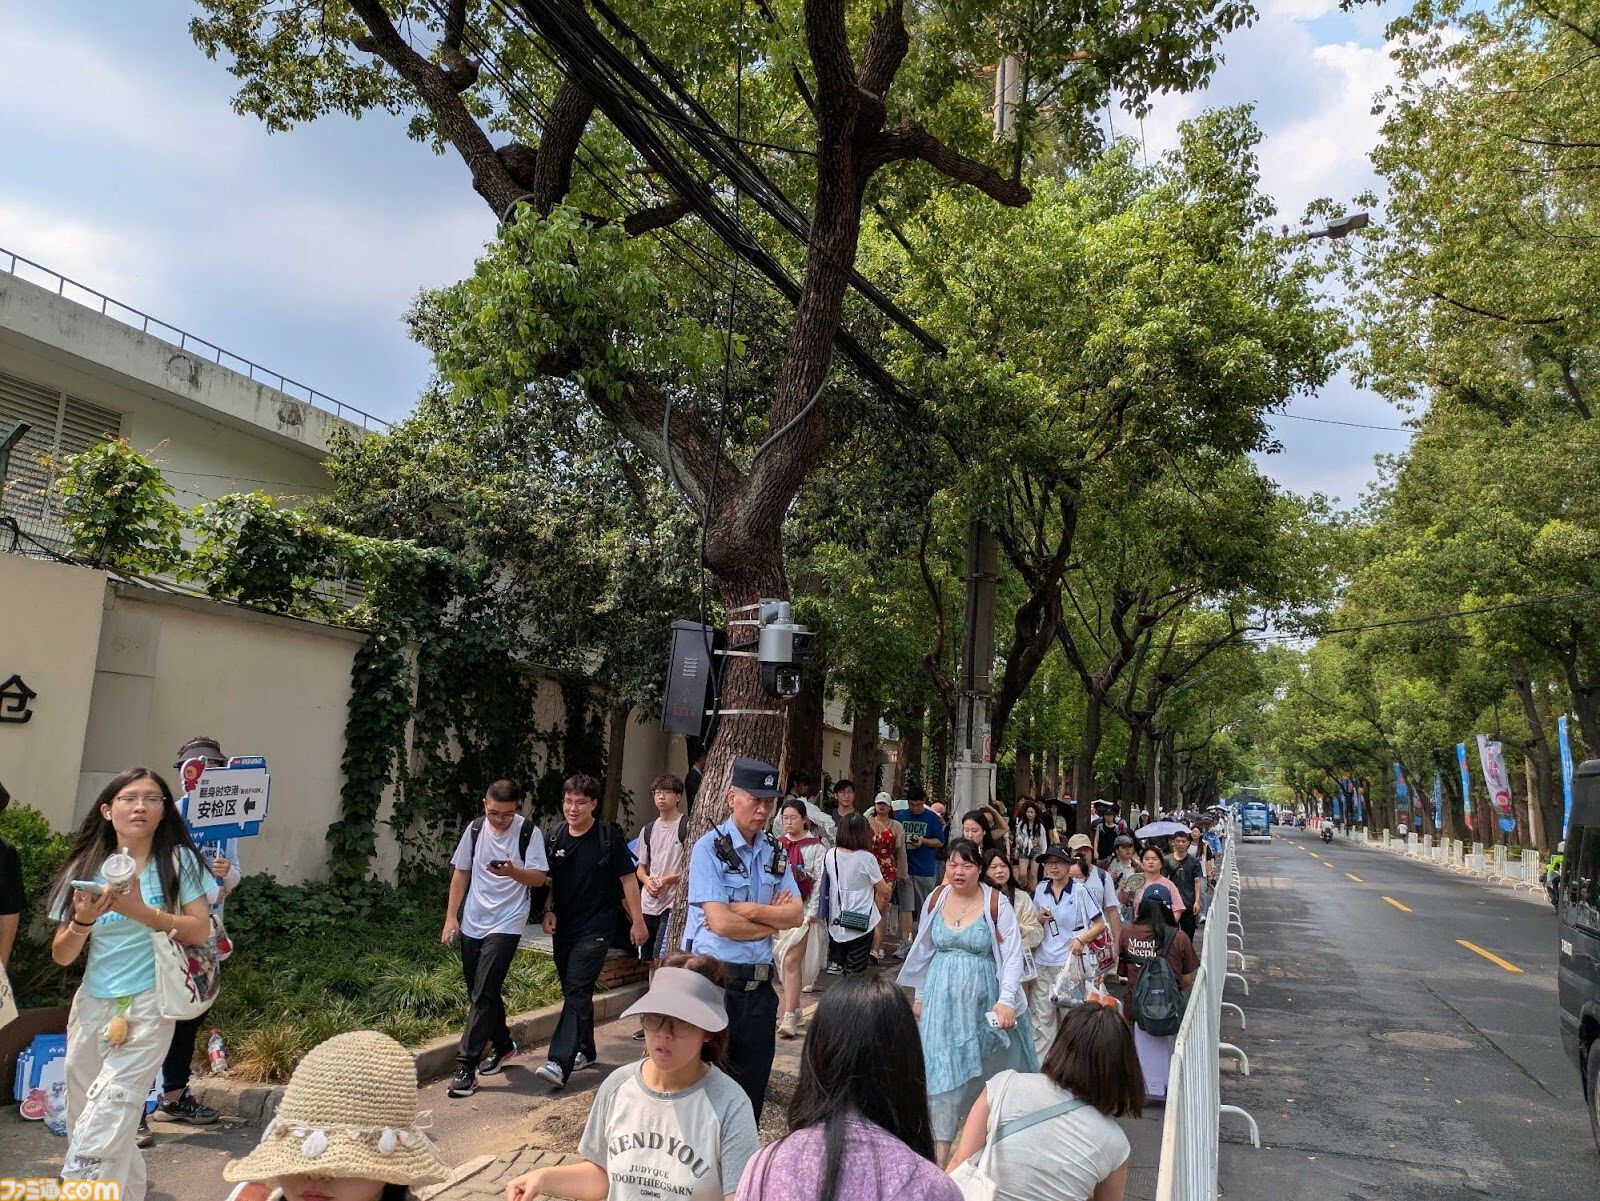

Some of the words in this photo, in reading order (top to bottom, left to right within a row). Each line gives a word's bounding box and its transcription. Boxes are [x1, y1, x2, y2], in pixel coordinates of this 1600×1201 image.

[0, 674, 38, 723] 仓
[198, 799, 238, 819] 安检区
